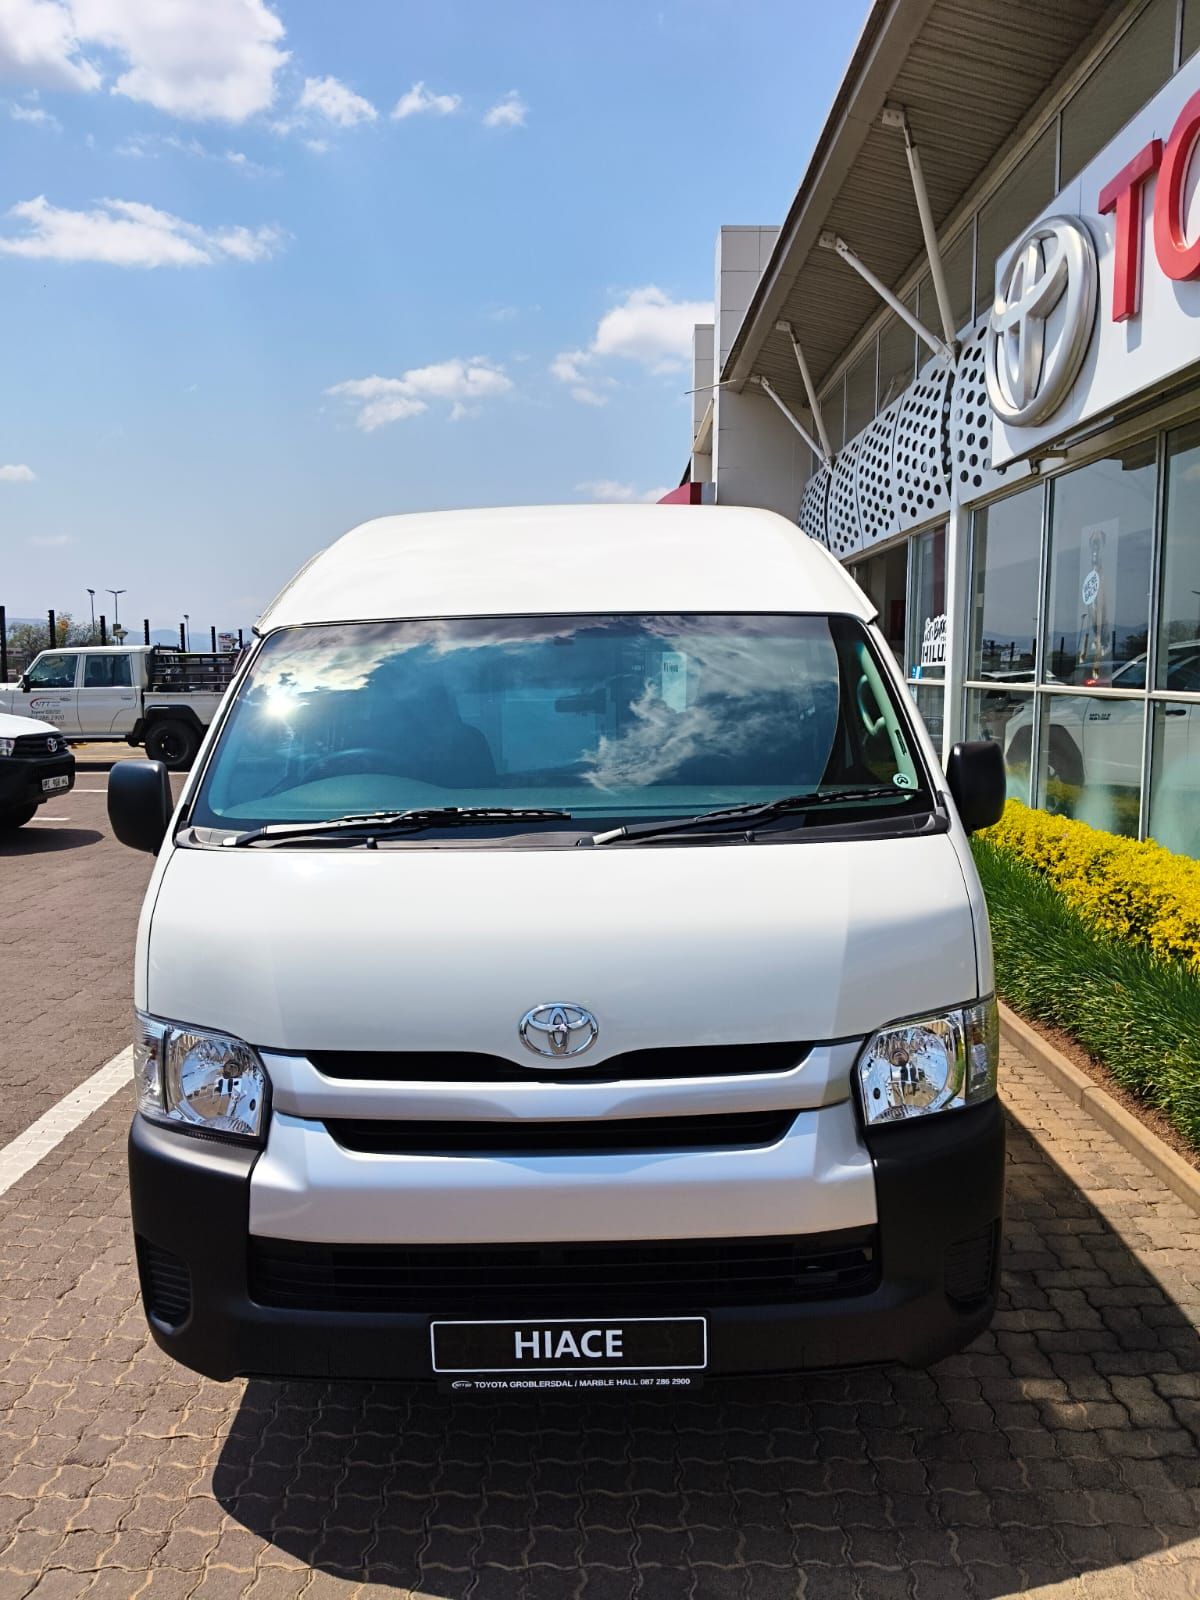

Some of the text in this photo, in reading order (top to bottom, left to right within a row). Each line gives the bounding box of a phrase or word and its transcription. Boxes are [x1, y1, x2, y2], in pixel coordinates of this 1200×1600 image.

[922, 644, 946, 663] HILU
[514, 1329, 623, 1359] HIACE
[474, 1381, 508, 1389] TOYOTA
[510, 1380, 573, 1388] GROBLERSDAL
[579, 1379, 614, 1387] MARBLE
[616, 1378, 639, 1386] HALL
